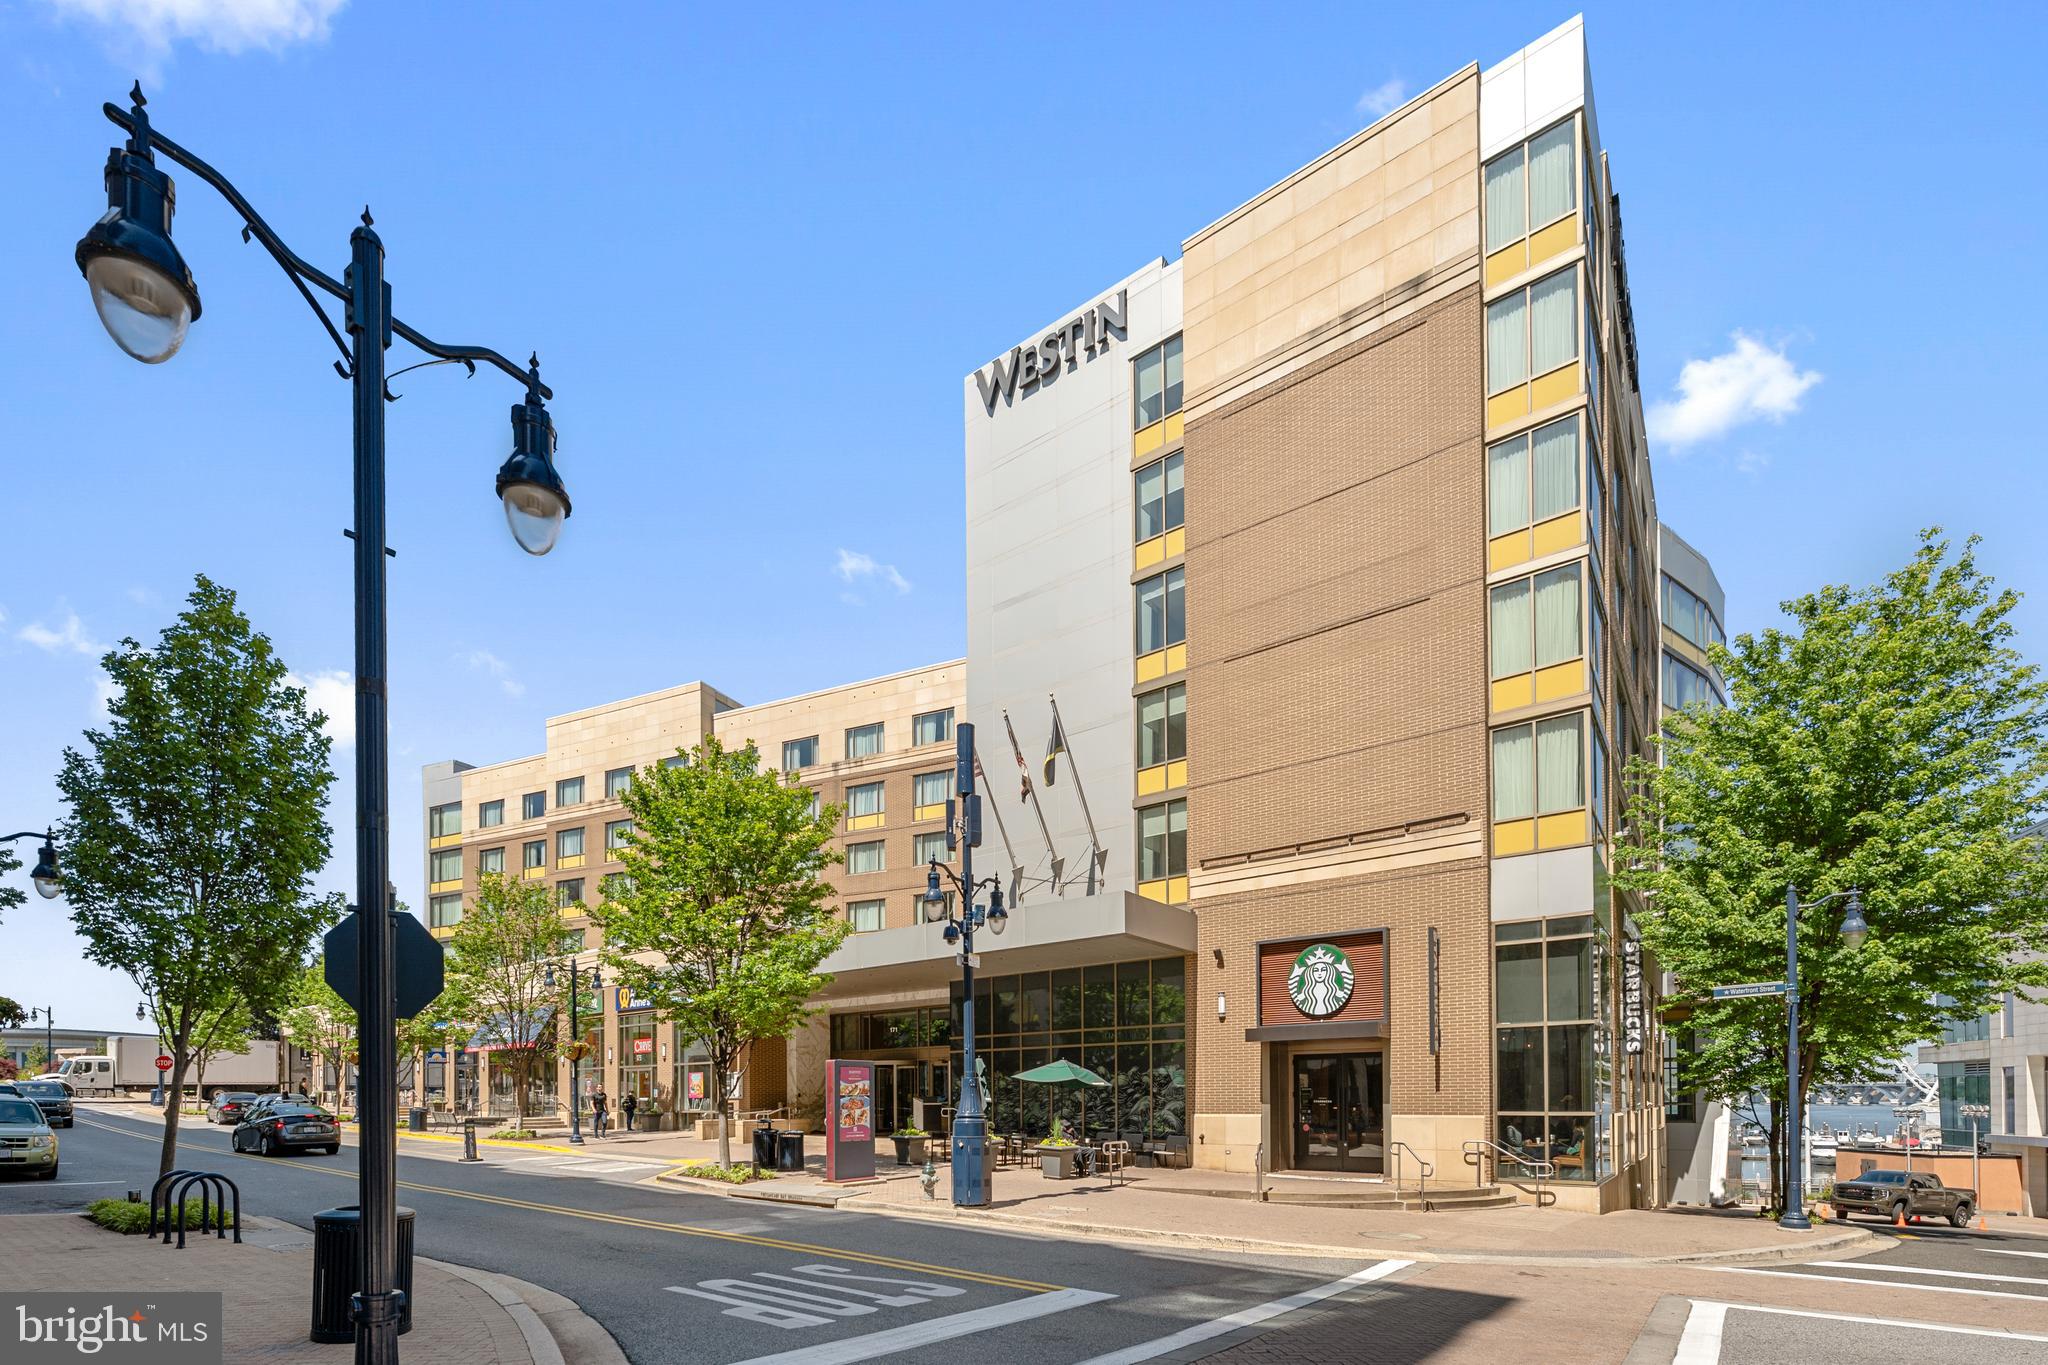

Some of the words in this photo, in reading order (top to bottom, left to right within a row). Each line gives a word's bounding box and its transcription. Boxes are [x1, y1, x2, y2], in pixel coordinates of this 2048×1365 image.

[974, 288, 1127, 409] WESTIN
[1625, 941, 1641, 1053] STARBUCKS
[1730, 987, 1758, 995] Waterfront
[662, 1264, 967, 1329] STOP
